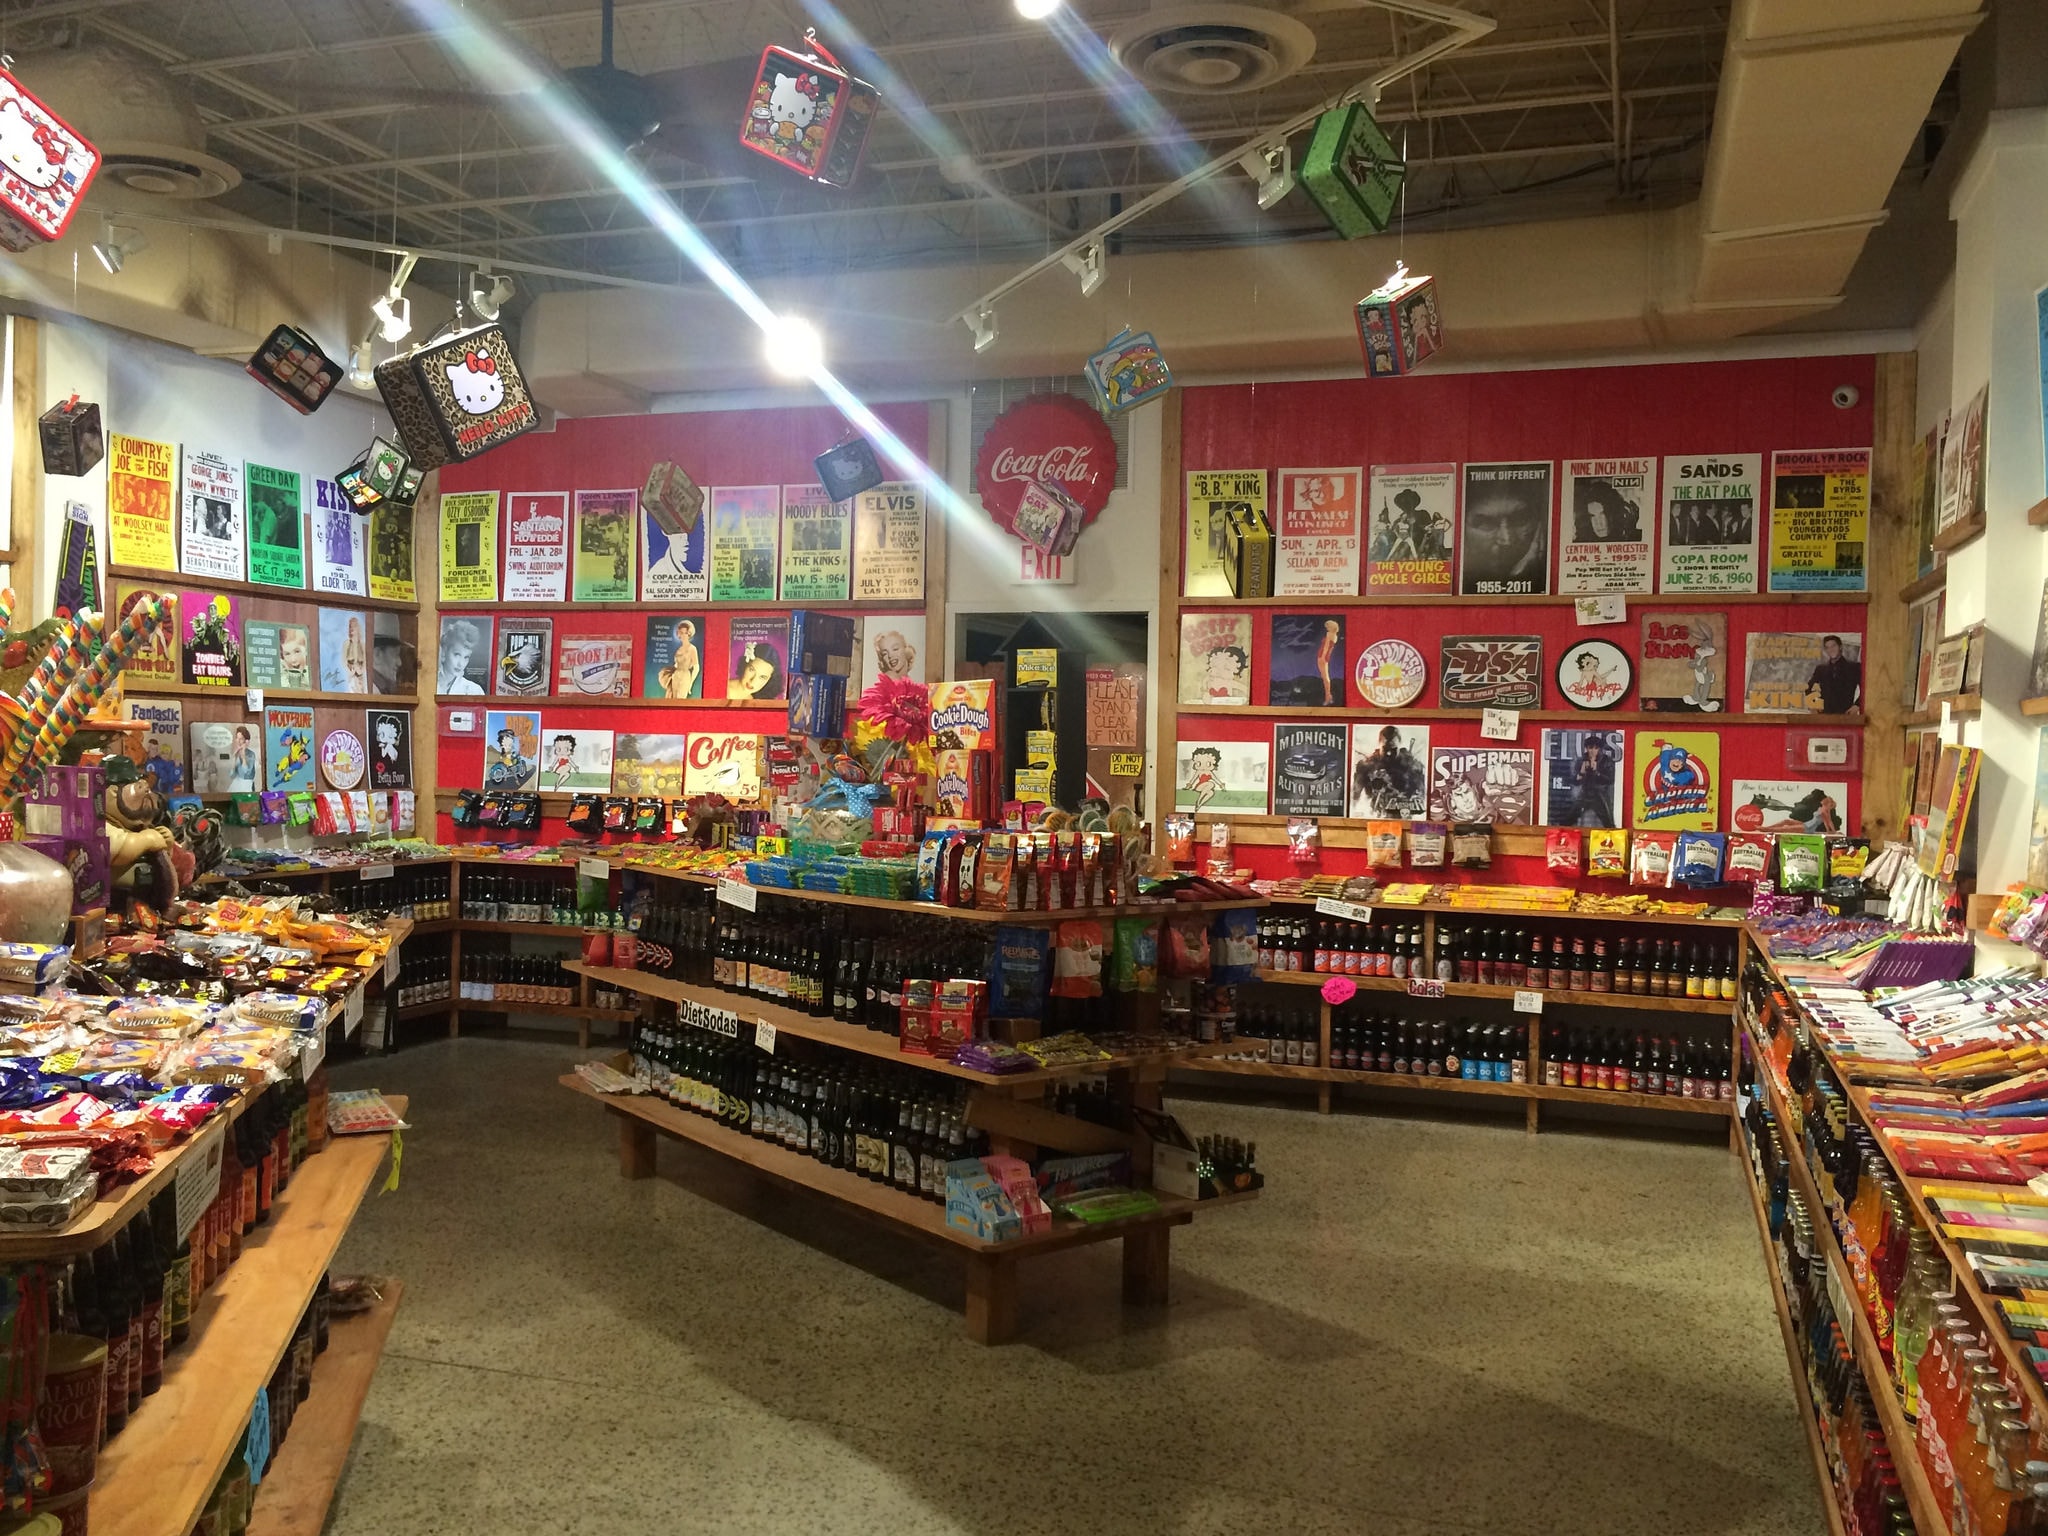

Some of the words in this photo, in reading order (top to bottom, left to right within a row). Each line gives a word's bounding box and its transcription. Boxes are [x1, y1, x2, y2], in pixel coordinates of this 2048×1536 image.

[6, 179, 58, 222] KITTY
[458, 419, 495, 445] HELLO
[496, 403, 529, 428] KITTY
[120, 438, 163, 460] COUNTRY
[115, 454, 131, 471] JOE
[148, 461, 168, 478] FISH
[991, 446, 1092, 482] Coca-Cola
[1776, 454, 1835, 464] BROOKLYN
[1838, 453, 1867, 463] ROCK
[191, 463, 212, 479] GEORGE
[215, 469, 233, 483] JONES
[1470, 471, 1496, 481] THINK
[1498, 470, 1546, 480] DIFFERENT
[1570, 462, 1591, 476] NINE
[1594, 461, 1616, 475] INCH
[1620, 460, 1649, 474] NAILS
[1680, 464, 1744, 479] SANDS
[250, 466, 275, 483] GREEN
[278, 471, 295, 488] DAY
[187, 478, 207, 492] TAMMY
[210, 483, 239, 500] WYNETTE
[1234, 480, 1260, 495] KING
[1673, 485, 1693, 499] THE
[1696, 484, 1720, 499] RAT
[1722, 484, 1752, 498] PACK
[865, 496, 915, 511] ELVIS
[72, 512, 89, 522] SIGN
[447, 506, 460, 519] OZZY
[464, 505, 490, 518] OSBOURNE
[785, 505, 818, 519] MOODY
[821, 504, 848, 518] BLUES
[1816, 510, 1864, 518] BUTTERFLY
[113, 515, 120, 525] AT
[123, 517, 152, 531] WOOLSEY
[154, 521, 169, 534] HALL
[513, 521, 562, 532] SANTANA
[1281, 539, 1305, 550] SUN.
[1316, 539, 1342, 550] APR.
[1346, 538, 1356, 549] 13
[1832, 533, 1848, 541] JOE
[1606, 543, 1649, 553] WORCESTER
[508, 562, 526, 570] SWING
[529, 561, 564, 571] AUDITORIUM
[793, 557, 810, 566] THE
[813, 556, 840, 566] KINKS
[1021, 545, 1061, 580] EXIT
[1287, 558, 1320, 568] SELLAND
[1323, 557, 1348, 568] ARENA
[1565, 555, 1590, 563] JAN.
[1612, 554, 1637, 562] 1995
[1671, 555, 1704, 564] COPA
[1710, 554, 1748, 564] ROOM
[284, 569, 300, 579] 1994
[448, 569, 487, 577] FOREIGNER
[1252, 542, 1263, 597] PEANUTS
[1376, 561, 1395, 571] THE
[1397, 561, 1445, 573] YOUNG
[322, 576, 340, 588] ELDER
[342, 579, 358, 591] TOUR
[785, 575, 806, 584] MAY
[810, 575, 818, 583] 15
[826, 574, 845, 583] 1964
[1369, 573, 1409, 585] CYCLE
[1411, 572, 1451, 585] GIRLS
[1665, 573, 1694, 585] JUNE
[1726, 572, 1753, 583] 1960
[1476, 581, 1532, 593] 1955-2011
[1649, 622, 1689, 640] BUGS
[566, 648, 601, 666] MOON
[1644, 641, 1700, 660] BUNNY
[195, 653, 225, 665] ZOMBIES
[1463, 649, 1537, 677] BSA
[192, 664, 205, 676] EAT
[1017, 664, 1038, 672] Mike
[1088, 680, 1137, 700] PLEASE
[1474, 689, 1493, 699] POPULAR
[1749, 690, 1824, 709] KING
[131, 704, 180, 722] Fantastic
[1092, 700, 1131, 715] STAND
[268, 710, 312, 728] WOLVERINE
[931, 706, 961, 731] Cookie
[960, 703, 990, 729] Dough
[1095, 716, 1129, 729] CLEAR
[151, 722, 180, 735] Four
[960, 727, 977, 737] Bites
[1088, 731, 1103, 744] OF
[1108, 730, 1135, 743] DOOR
[1279, 730, 1345, 751] MIDNIGHT
[689, 736, 756, 770] Coffee
[1112, 755, 1122, 763] DO
[1126, 755, 1141, 763] NOT
[1114, 763, 1140, 774] ENTER
[1434, 751, 1530, 788] SUPERMAN
[1016, 784, 1034, 792] Mike
[1278, 775, 1305, 796] AUTO
[1309, 775, 1343, 796] PARTS
[1409, 980, 1444, 997] Colas
